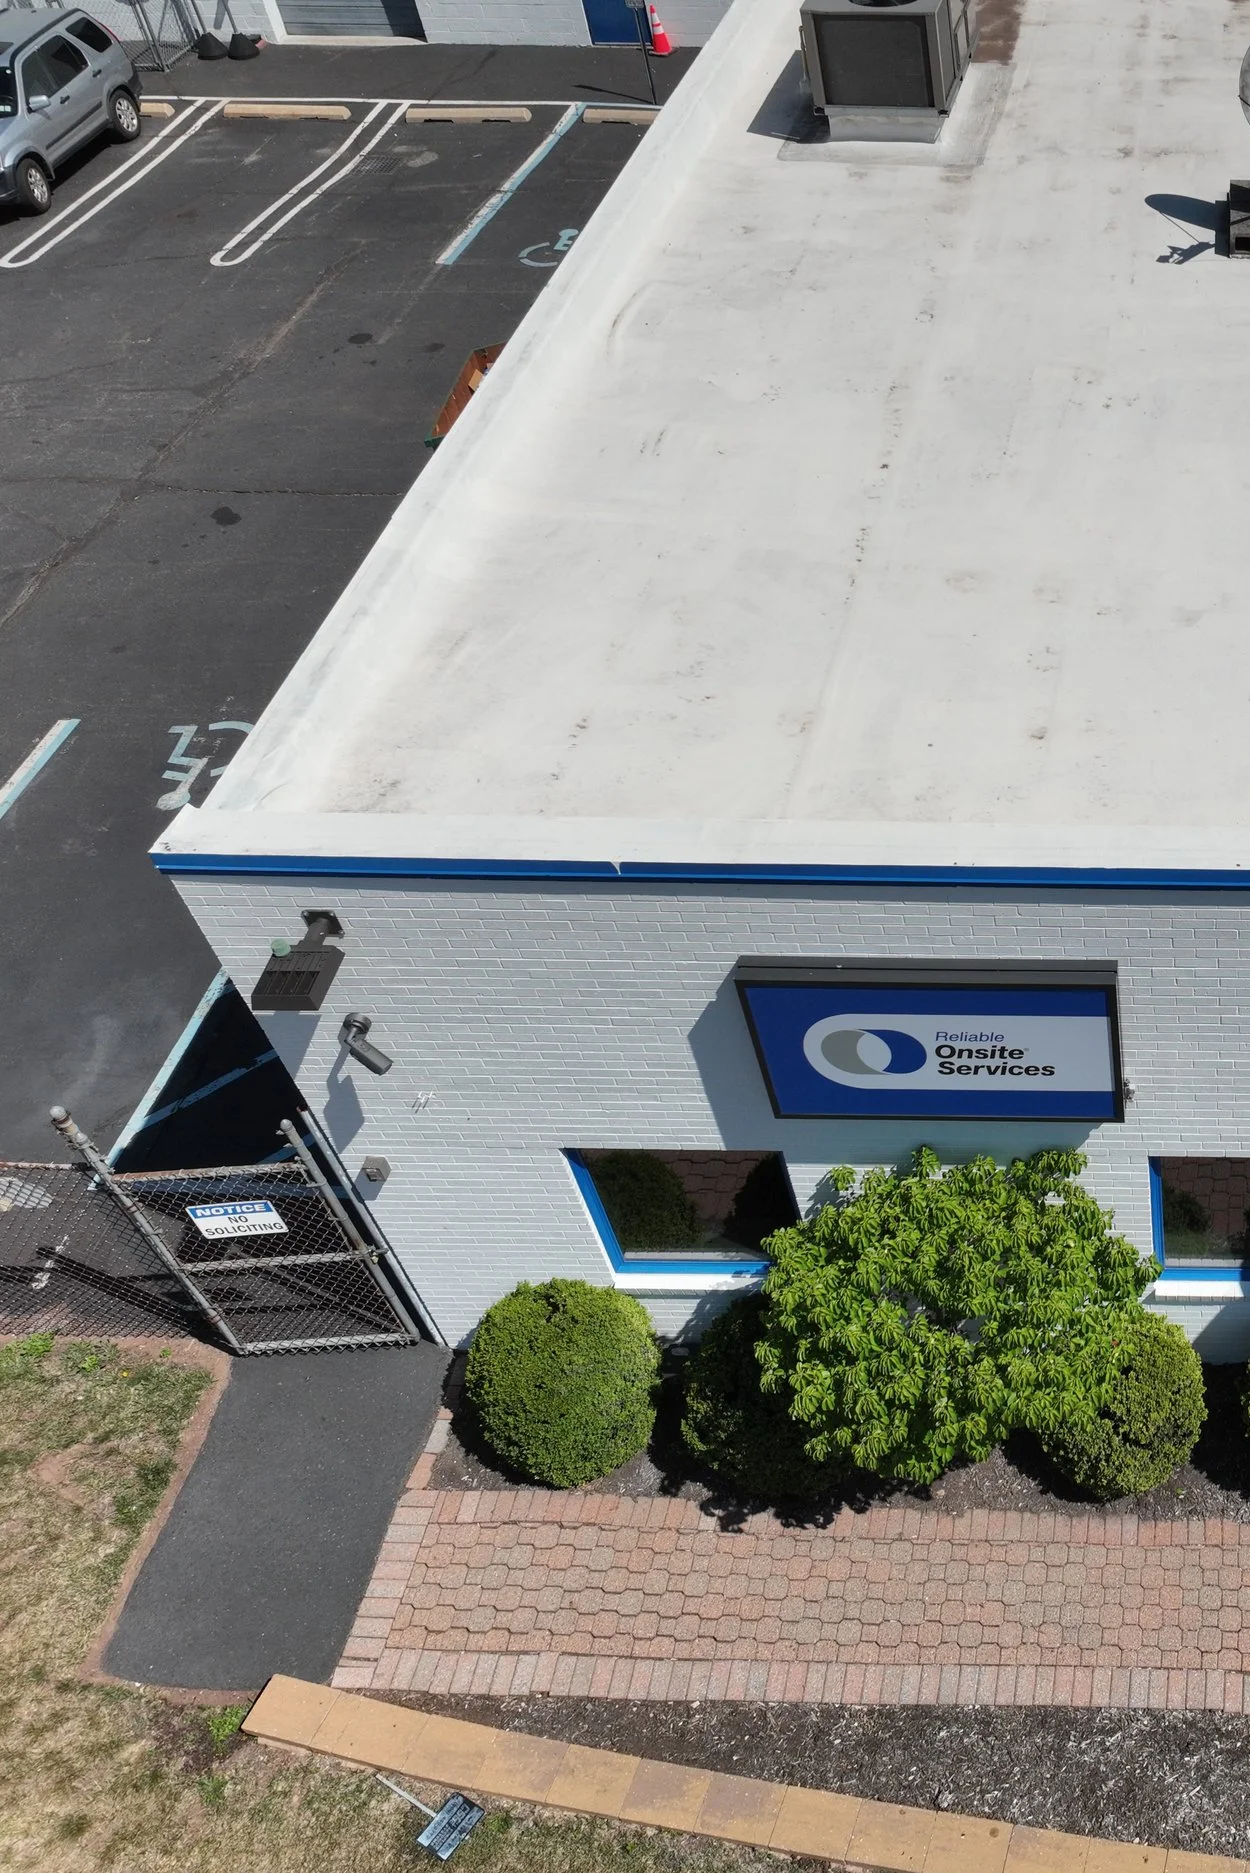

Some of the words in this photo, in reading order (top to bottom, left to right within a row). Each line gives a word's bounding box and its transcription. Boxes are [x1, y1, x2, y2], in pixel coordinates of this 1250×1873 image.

[935, 1031, 1005, 1042] Reliable
[935, 1044, 1025, 1059] Onsite
[937, 1061, 1056, 1076] Services
[195, 1204, 266, 1216] NOTICE
[227, 1215, 249, 1224] NO
[205, 1222, 283, 1235] SOLICITING
